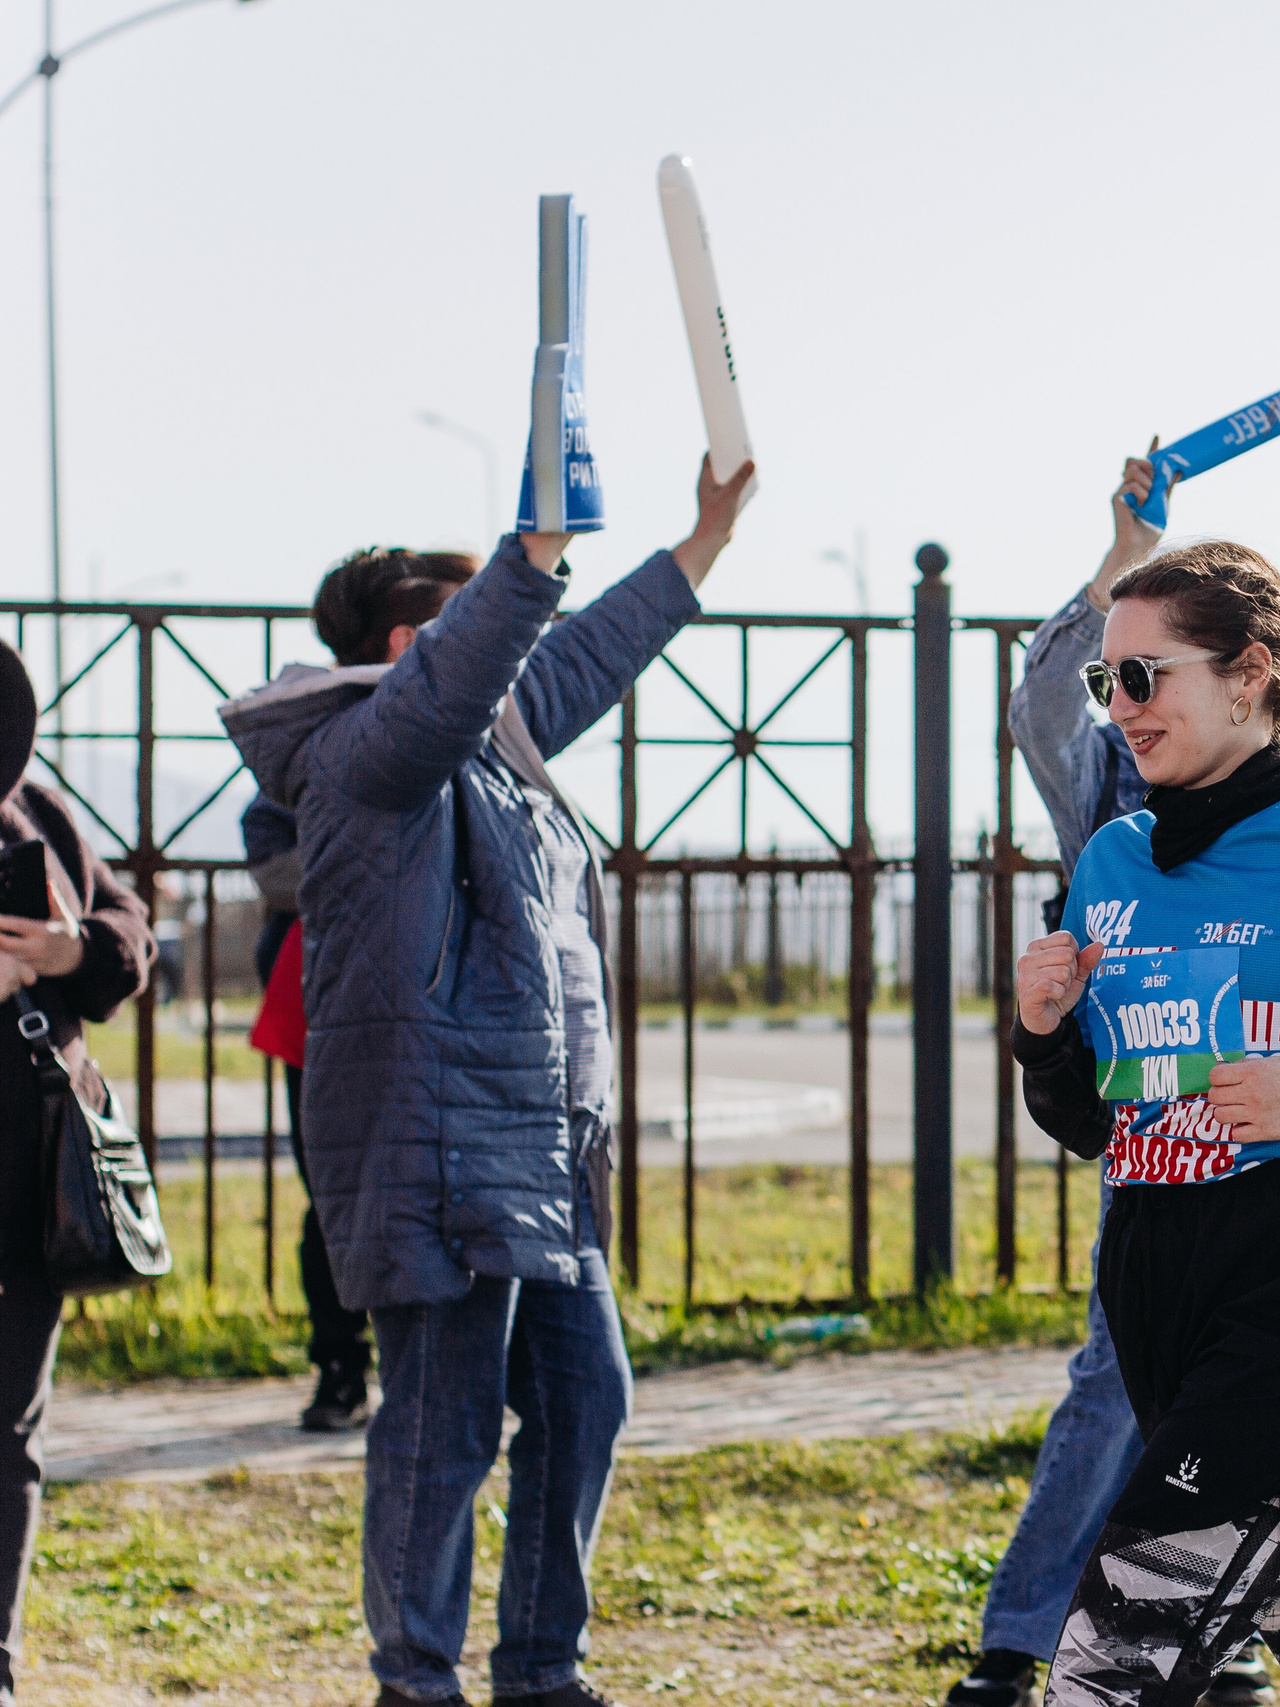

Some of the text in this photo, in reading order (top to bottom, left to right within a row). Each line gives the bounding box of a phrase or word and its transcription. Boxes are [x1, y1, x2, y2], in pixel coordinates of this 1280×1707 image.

[1106, 963, 1126, 976] ПСБ
[1116, 998, 1201, 1050] 10033
[1165, 1474, 1199, 1494] VANSYDICAL
